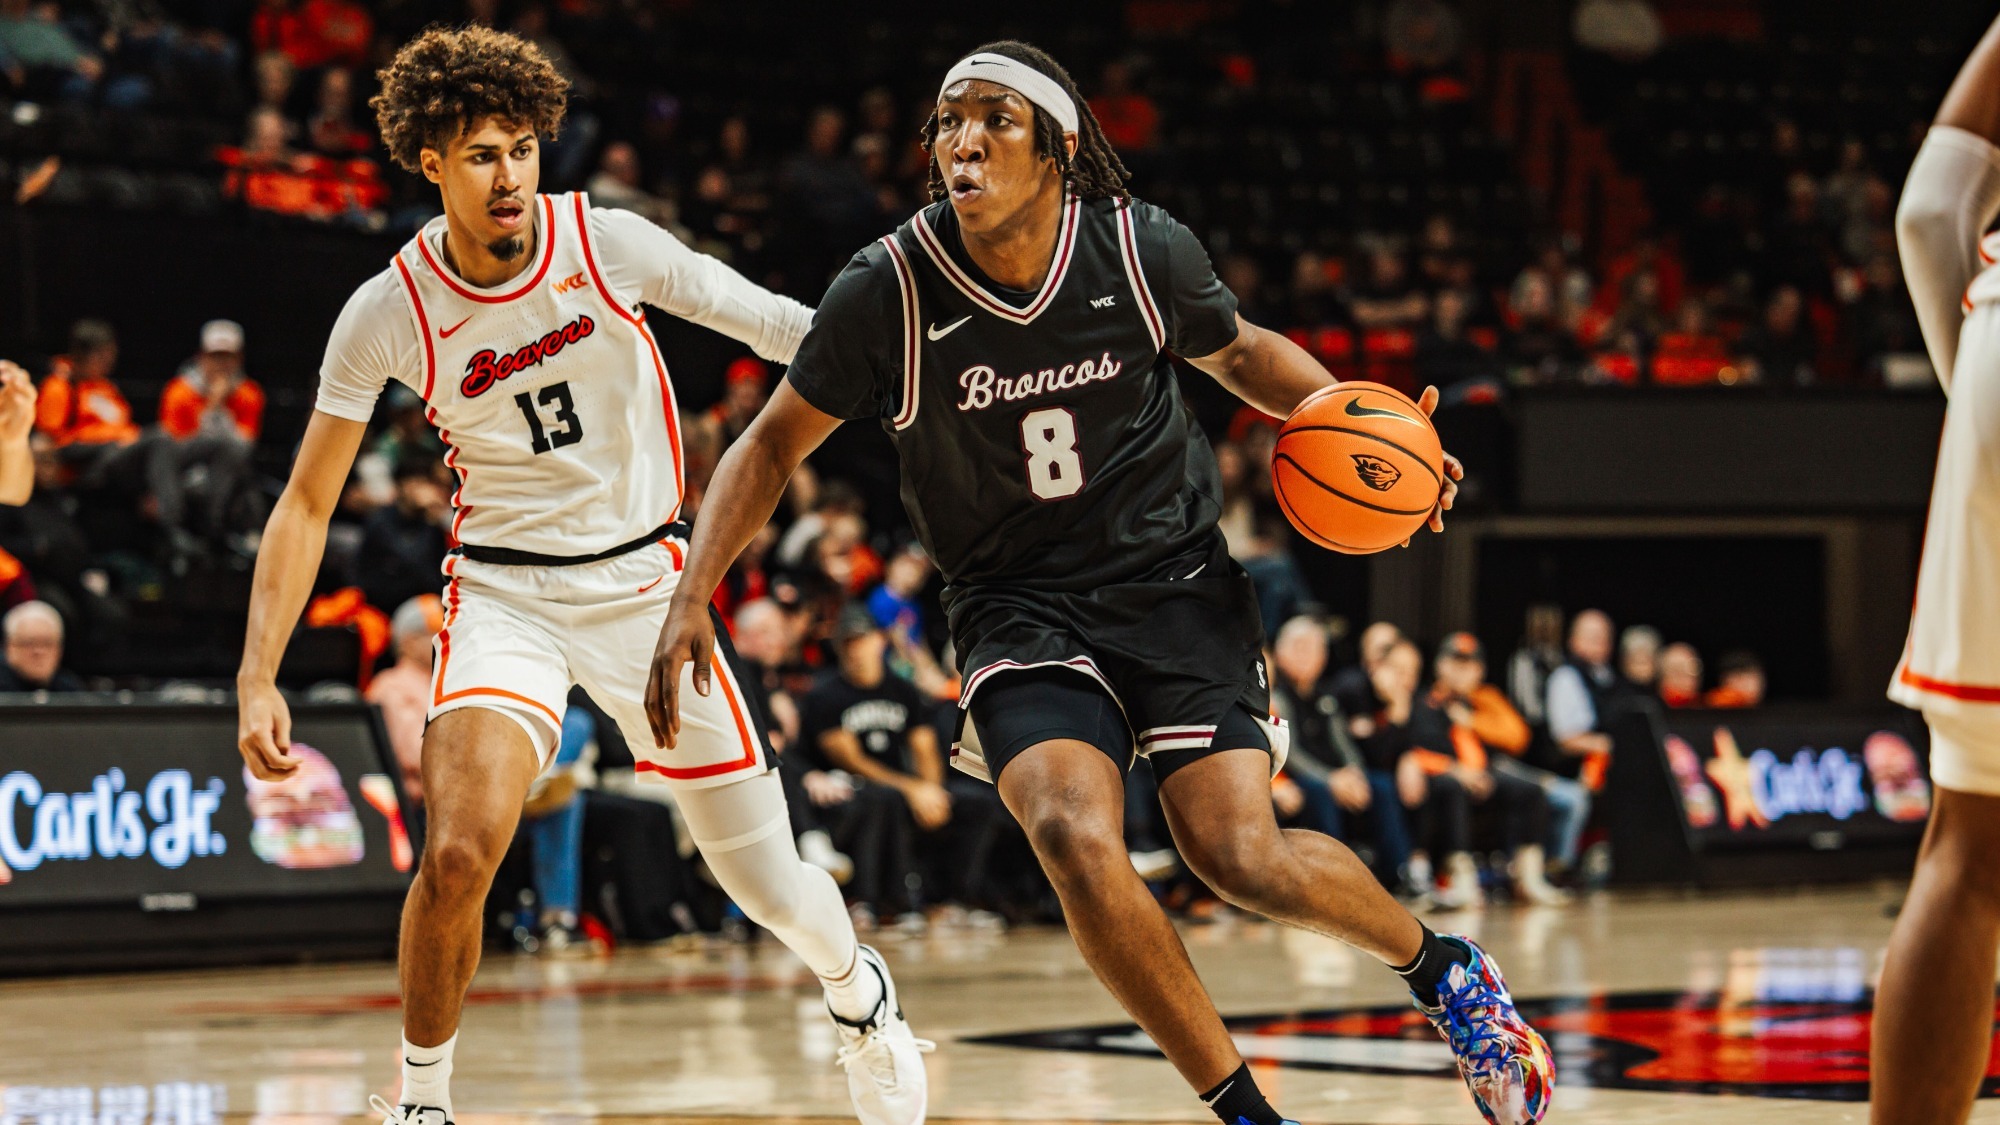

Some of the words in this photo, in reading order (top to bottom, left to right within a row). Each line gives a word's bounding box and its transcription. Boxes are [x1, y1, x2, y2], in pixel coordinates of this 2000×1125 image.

[552, 271, 588, 295] WCC
[1089, 295, 1116, 309] WCC
[460, 314, 595, 398] Beavers
[957, 351, 1122, 412] Broncos
[513, 380, 584, 455] 13
[1019, 405, 1086, 502] 8
[0, 766, 147, 871] Carl's
[145, 768, 228, 869] Jr.
